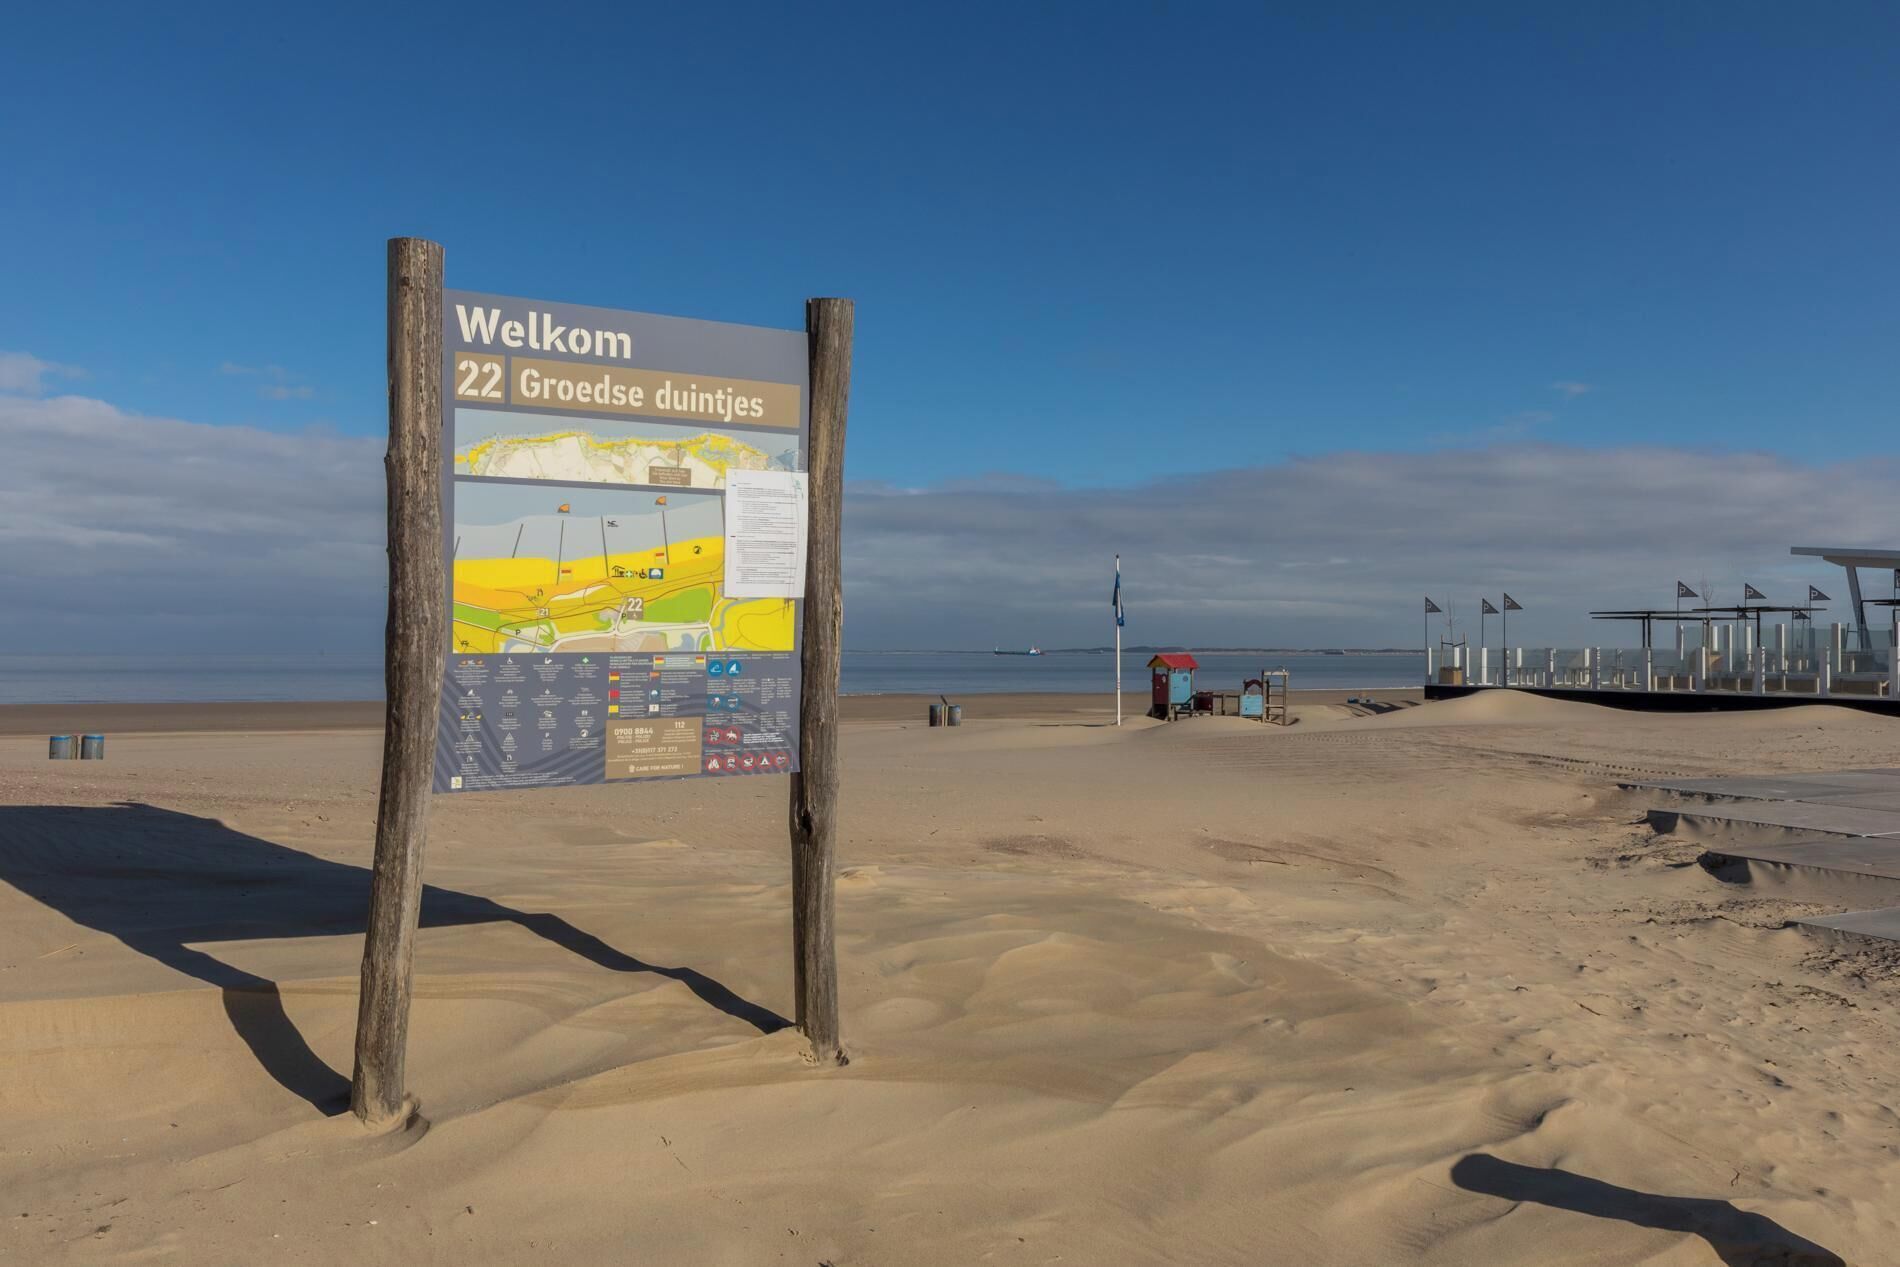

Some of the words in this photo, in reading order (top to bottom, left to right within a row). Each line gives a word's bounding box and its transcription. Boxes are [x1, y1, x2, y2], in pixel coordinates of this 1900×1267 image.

[455, 304, 632, 359] Welkom
[457, 359, 502, 399] 22
[520, 367, 644, 407] Groedse
[655, 380, 764, 422] duintjes
[628, 598, 643, 611] 22
[540, 608, 549, 616] 21
[614, 728, 633, 736] 0900
[634, 727, 653, 735] 8844
[675, 721, 685, 729] 112
